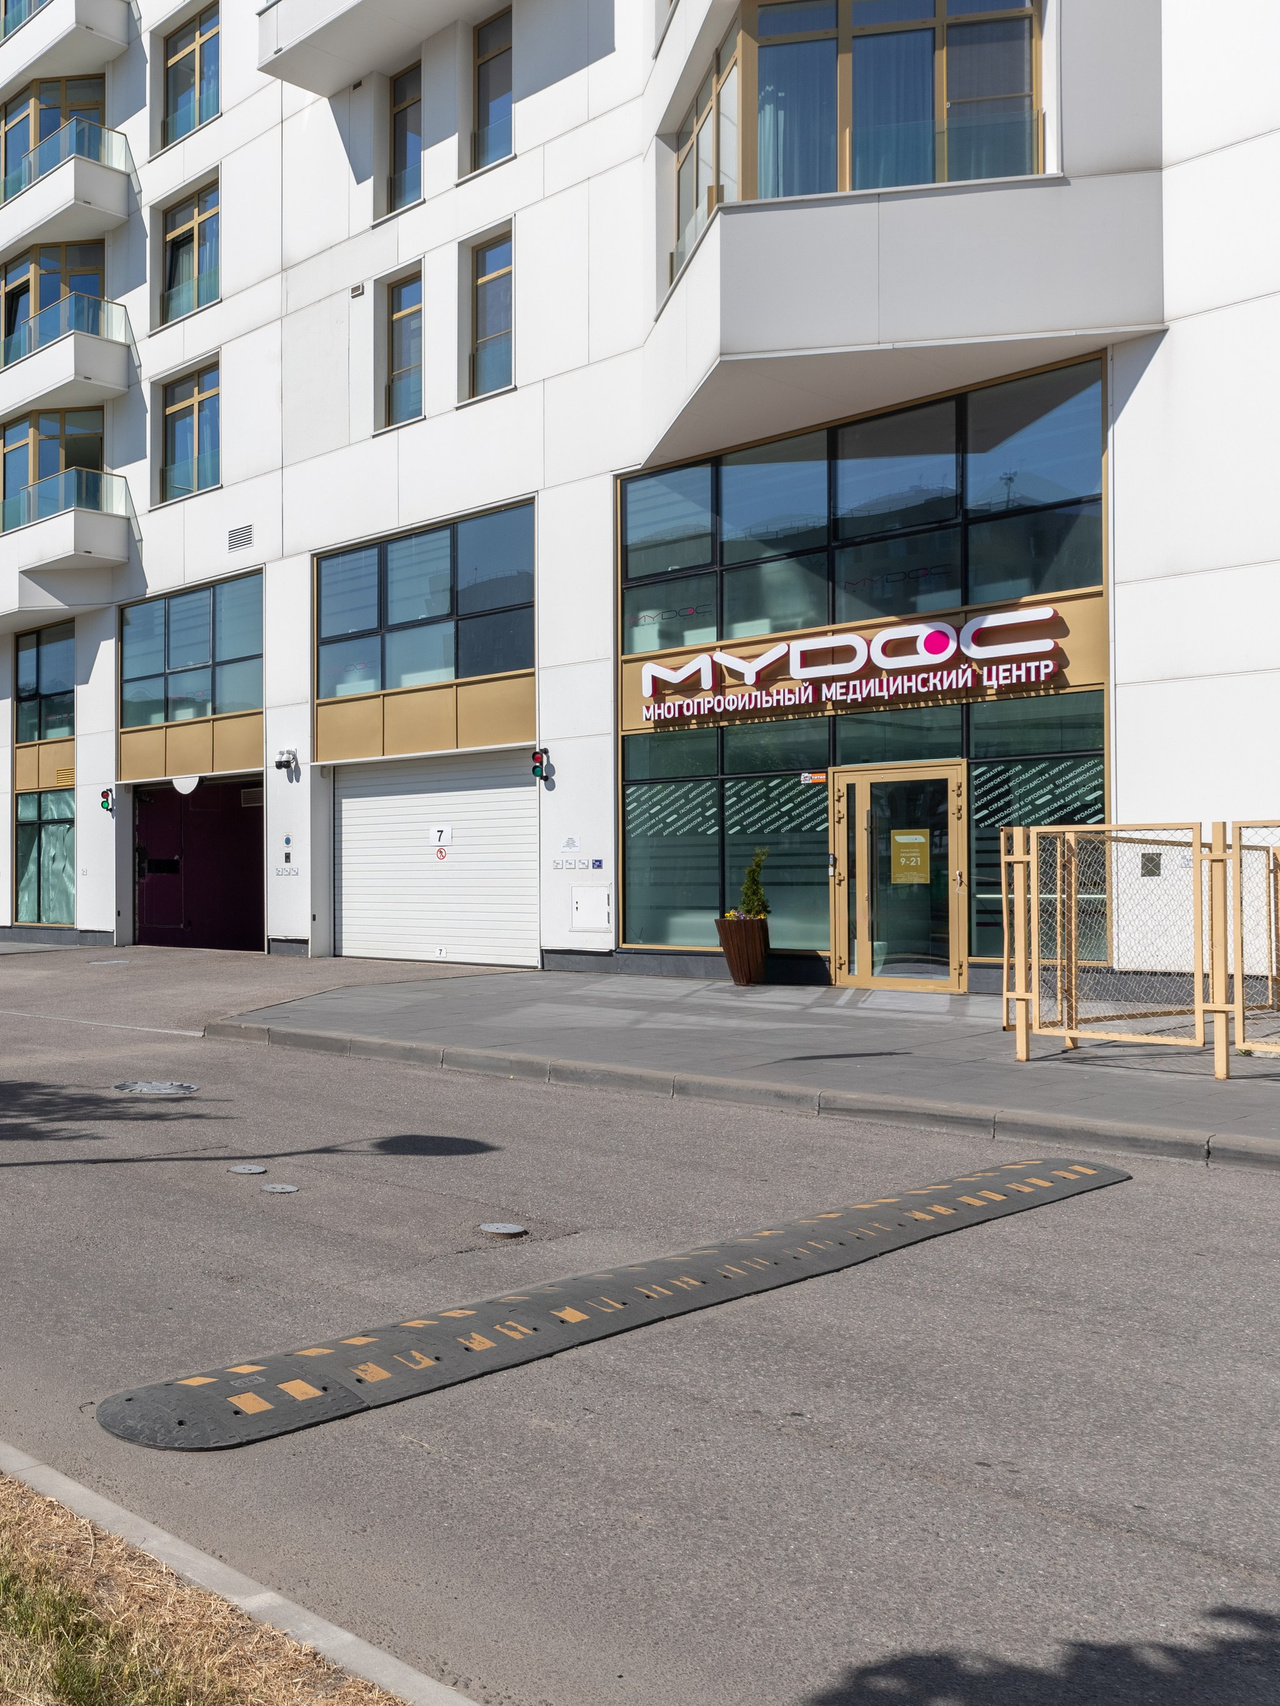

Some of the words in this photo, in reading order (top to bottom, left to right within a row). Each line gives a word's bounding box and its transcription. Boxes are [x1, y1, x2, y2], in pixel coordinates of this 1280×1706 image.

[641, 606, 1057, 697] MYDOC
[642, 681, 814, 721] МНОГОПРОФИЛЬНЫЙ
[821, 663, 973, 704] МЕДИЦИНСКИЙ
[982, 659, 1055, 690] ЦЕНТР
[972, 785, 1009, 810] ЛАБОРАТОРНЫЕ
[1009, 761, 1049, 787] ИССЛЕДОВАНИ
[974, 764, 1022, 796] КОЛОПРОКТОЛОГИЯ
[988, 793, 1014, 812] СЕРДЕЧНО
[1015, 773, 1050, 797] СОСУДИСТАЯ
[1050, 760, 1073, 777] ХИРУРГИ
[1054, 764, 1104, 795] ЭНДОКРИНОЛОГИЯ
[1055, 759, 1099, 786] ПУЛЬМОНОЛОГ
[769, 777, 801, 798] НЕЙРОХИРУРГИ
[780, 784, 806, 803] ДИАГНОСТИК
[1021, 799, 1064, 825] УЛЬТРАЗВУКОВАЯ
[1065, 778, 1103, 802] ДИАГНОСТИКА
[979, 803, 1020, 829] ТРАВМАТОЛОГИЯ
[1024, 784, 1054, 803] ОРТОПЕДИЯ
[995, 805, 1032, 828] ФИЗИОТЕРАПИЯ
[1041, 802, 1081, 826] РЕВМАТОЛОГИЯ
[1073, 803, 1102, 821] УРОЛОГИЯ
[437, 830, 444, 842] 7
[900, 857, 921, 866] 9-21
